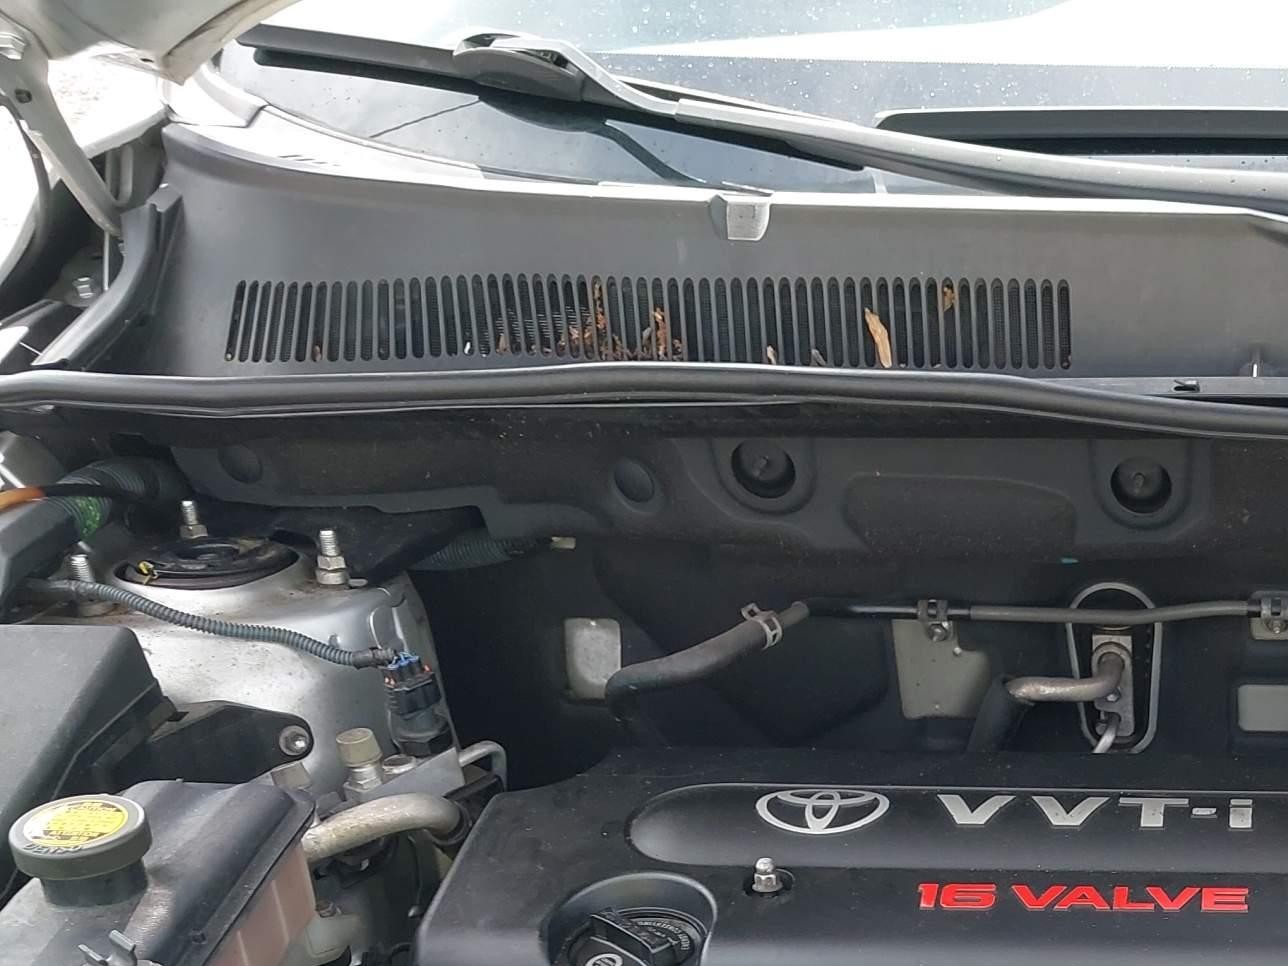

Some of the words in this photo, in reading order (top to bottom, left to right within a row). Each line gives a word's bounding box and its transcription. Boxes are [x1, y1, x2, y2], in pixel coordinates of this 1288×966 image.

[937, 794, 1253, 829] VVT-i
[918, 882, 997, 909] 16
[1011, 884, 1249, 912] VALVE
